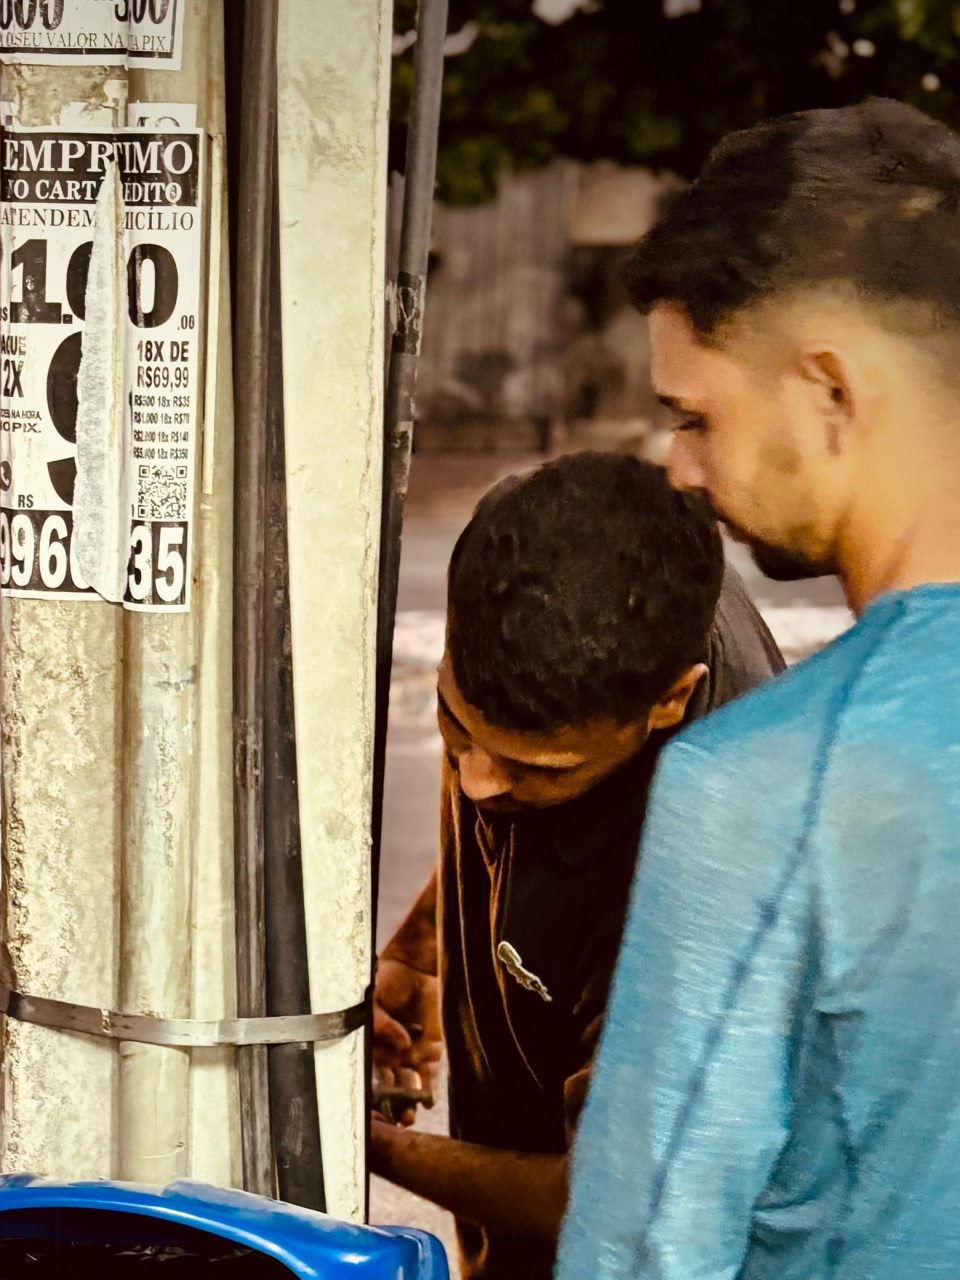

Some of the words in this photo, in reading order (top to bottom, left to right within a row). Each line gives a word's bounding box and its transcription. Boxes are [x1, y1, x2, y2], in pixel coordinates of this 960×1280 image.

[14, 32, 42, 47] SEU
[46, 33, 99, 48] VALOR
[103, 33, 124, 48] NA
[137, 340, 165, 362] 18X
[170, 341, 189, 362] DE
[137, 366, 189, 392] R$69,99
